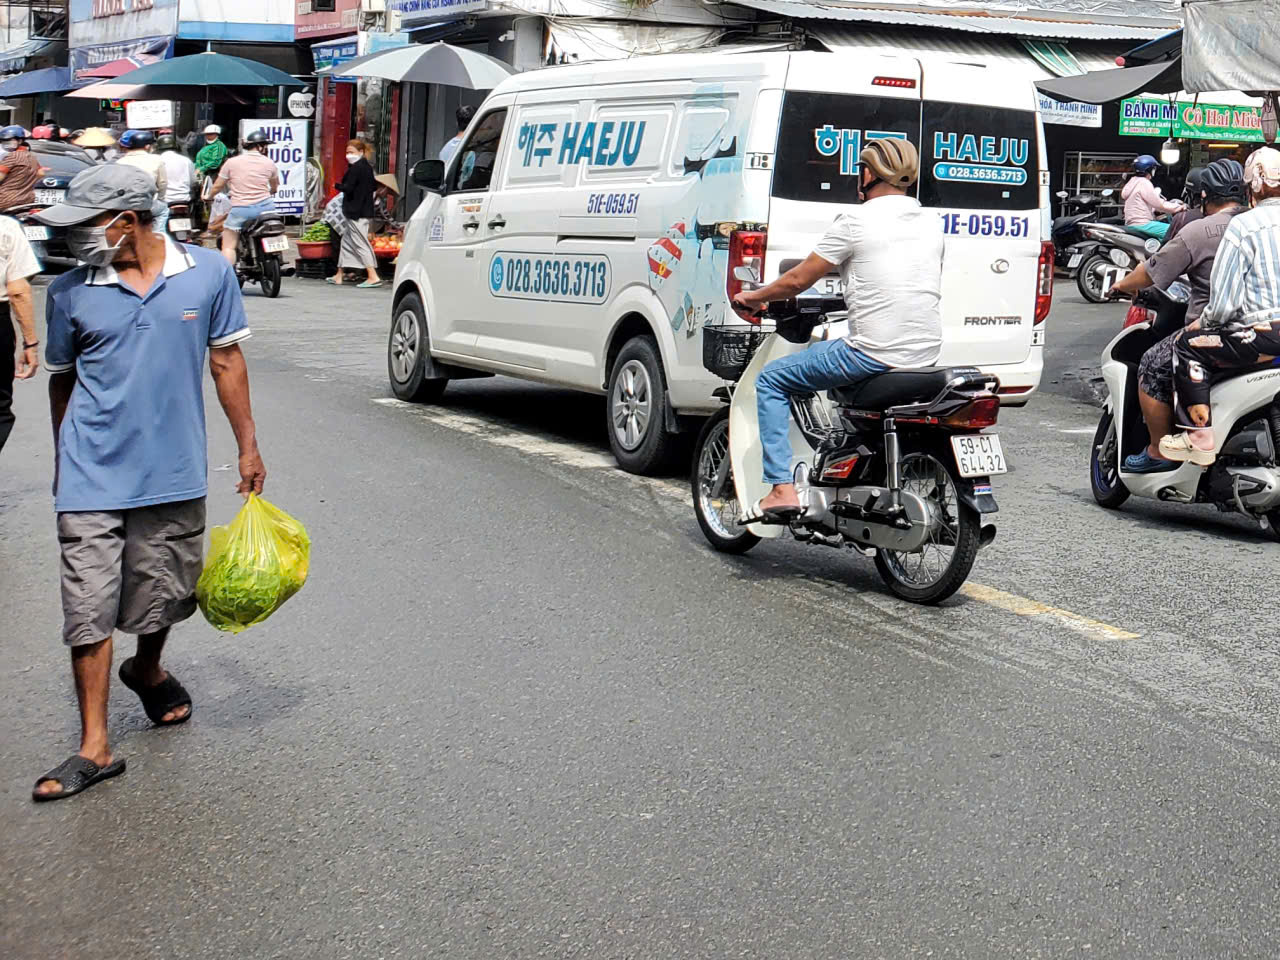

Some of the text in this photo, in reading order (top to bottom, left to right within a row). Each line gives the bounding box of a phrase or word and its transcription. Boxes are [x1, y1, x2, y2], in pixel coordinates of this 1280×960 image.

[290, 98, 311, 110] IPHONE
[1124, 99, 1158, 119] BÁNH
[1205, 109, 1229, 128] Hai
[260, 123, 294, 142] NHÀ
[270, 142, 302, 164] UỐC
[518, 121, 558, 168] 해주
[558, 120, 647, 167] HAEJU
[815, 124, 908, 176] 해
[933, 131, 1029, 166] HAEJU
[948, 166, 1023, 182] 028.3636.3713
[587, 193, 640, 214] 51E-059.51
[942, 213, 1029, 238] 1E-059.51
[506, 259, 606, 298] 028.3636.3713
[825, 279, 844, 294] 51
[964, 315, 1022, 326] FRONTIER
[960, 437, 993, 455] 59-C1
[961, 455, 1003, 474] 644.32
